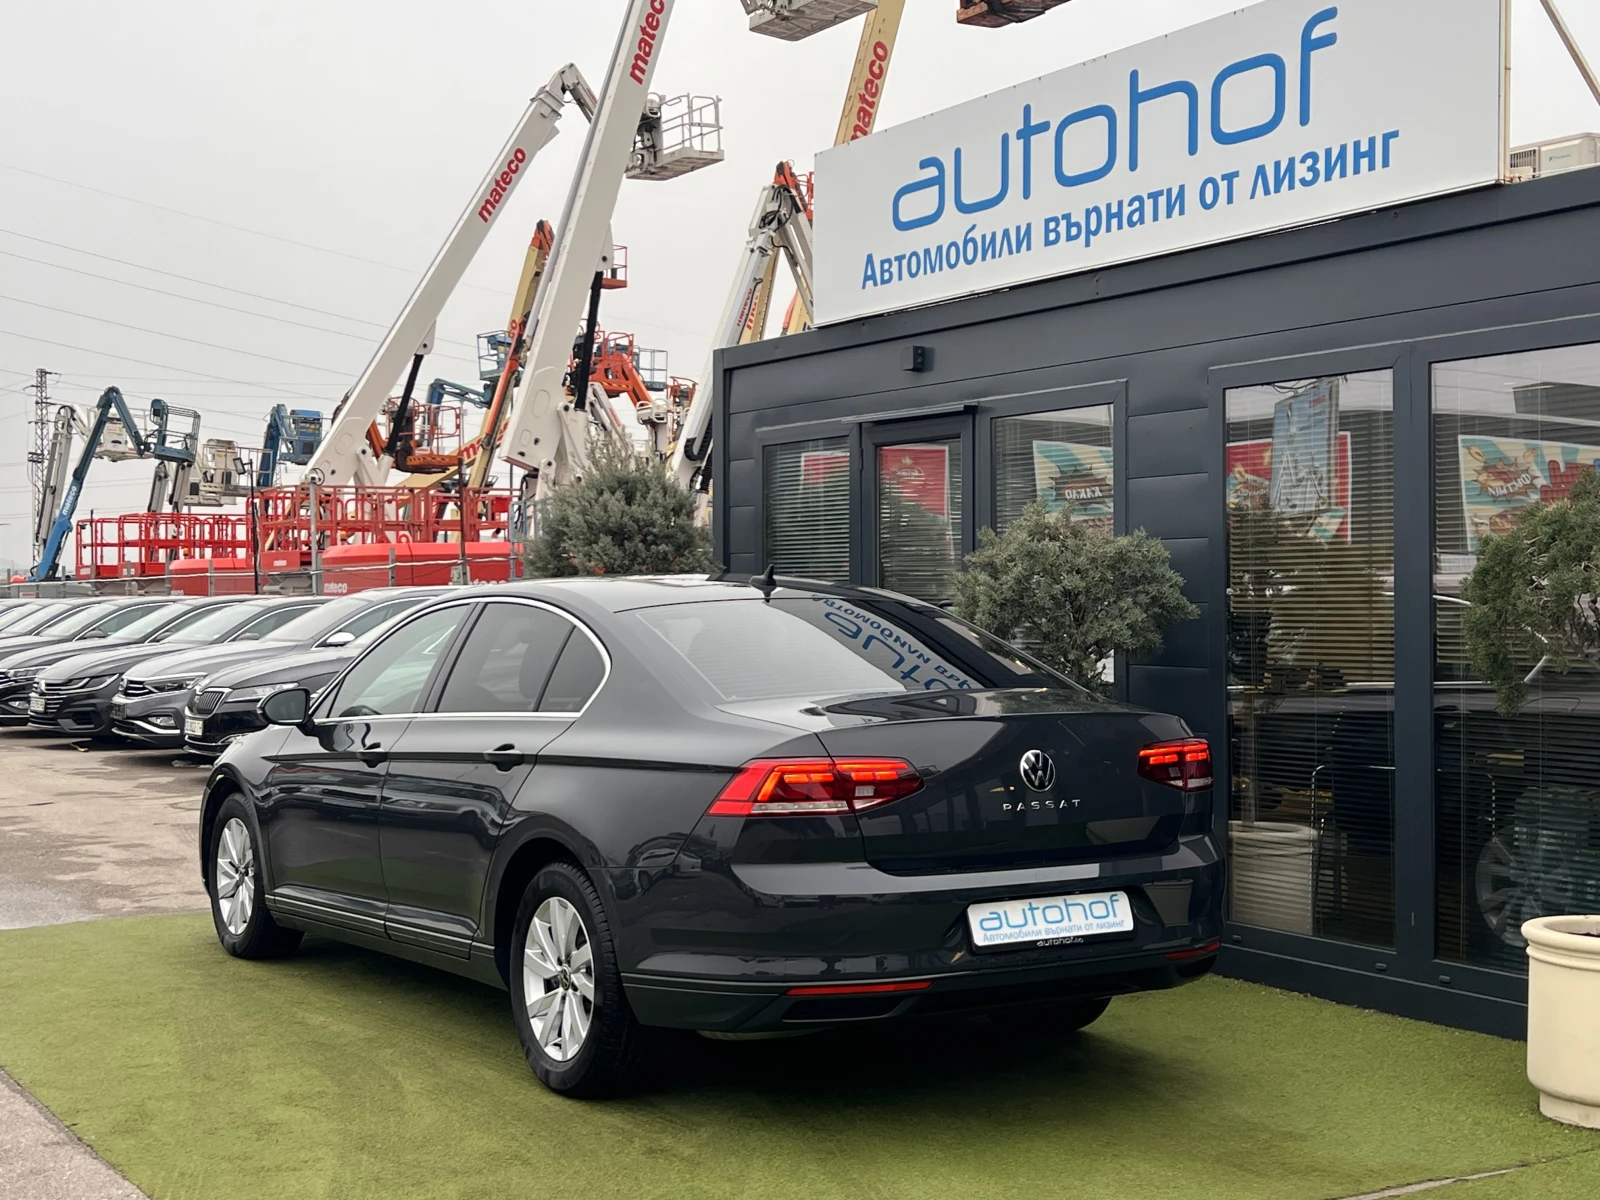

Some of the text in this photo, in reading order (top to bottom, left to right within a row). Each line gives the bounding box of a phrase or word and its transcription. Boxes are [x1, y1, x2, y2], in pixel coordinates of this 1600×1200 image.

[893, 6, 1338, 231] autohof
[478, 147, 526, 223] mateco
[861, 129, 1399, 289] Автомобили върнати от лизинг
[62, 485, 77, 516] mateco
[1002, 799, 1081, 811] PASSAT
[979, 893, 1119, 932] autohof
[983, 919, 1125, 943] Автомобили върнати от лизинг
